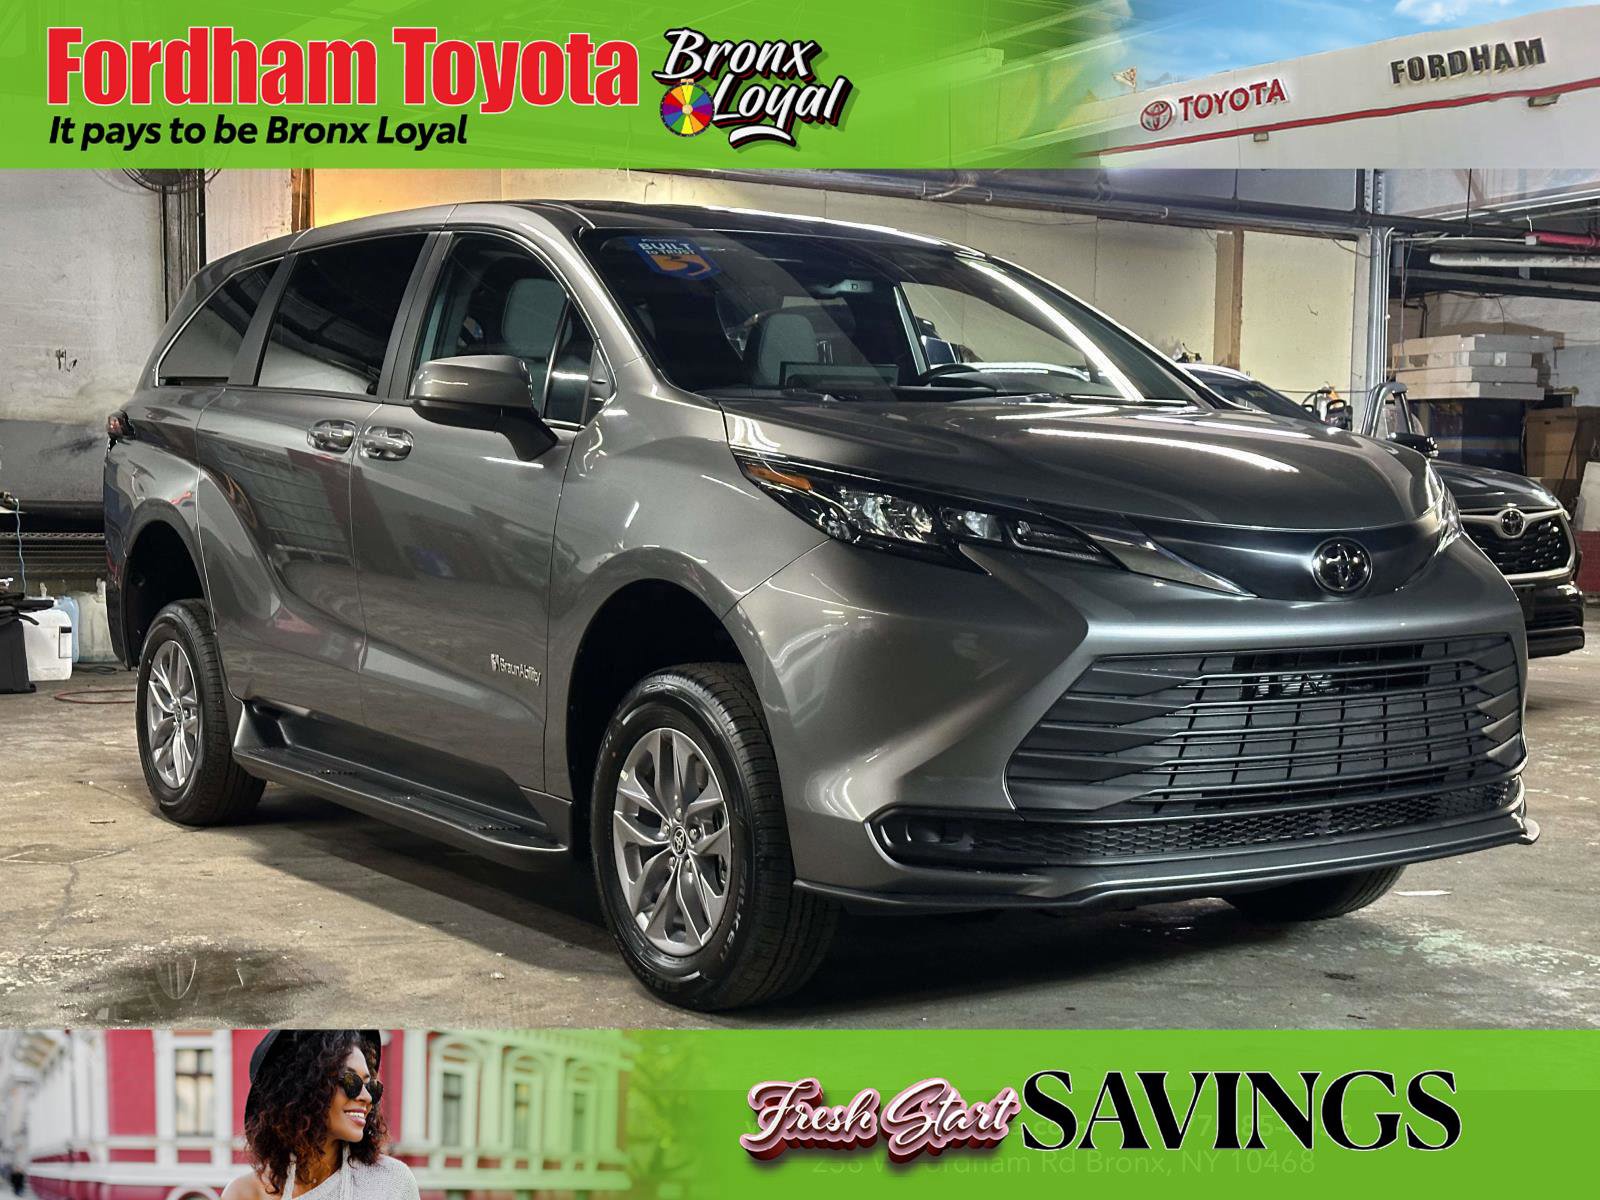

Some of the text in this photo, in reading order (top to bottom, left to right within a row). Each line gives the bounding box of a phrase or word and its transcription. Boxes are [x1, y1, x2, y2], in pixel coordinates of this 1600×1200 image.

[1390, 37, 1547, 85] FORDHAM
[1178, 78, 1288, 121] TOYOTA
[638, 242, 691, 250] BUILT
